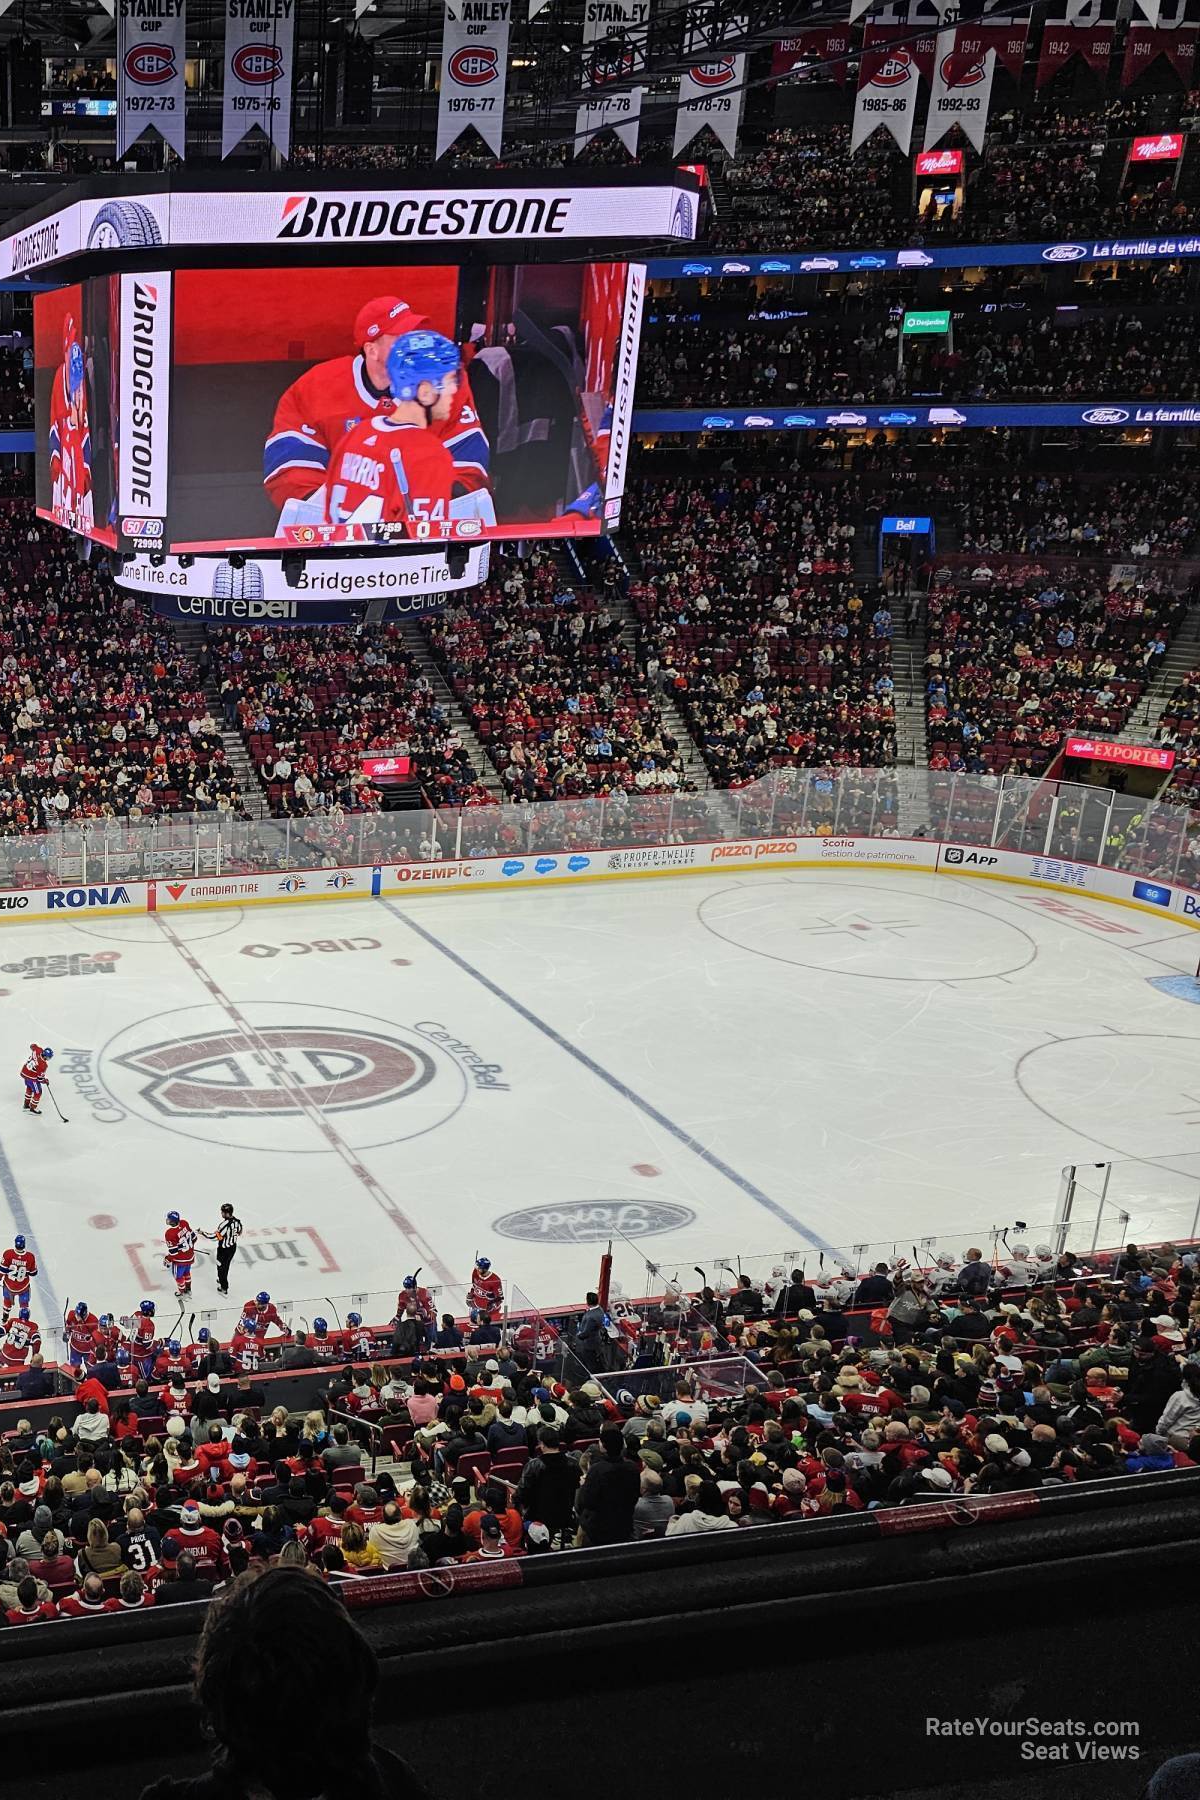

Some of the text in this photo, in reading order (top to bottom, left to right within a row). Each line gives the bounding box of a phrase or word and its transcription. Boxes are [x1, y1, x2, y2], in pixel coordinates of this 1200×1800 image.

[121, 0, 182, 18] STANLEY
[229, 0, 292, 18] STANLEY
[141, 20, 162, 32] CUP
[250, 21, 271, 33] CUP
[467, 24, 488, 36] CUP
[780, 38, 801, 52] 1952
[826, 38, 845, 52] 1963
[961, 40, 981, 54] 1947
[1048, 42, 1069, 55] 1942
[1091, 43, 1110, 56] 1960
[1134, 42, 1152, 56] 1941
[125, 97, 175, 111] 1972-73
[232, 97, 282, 111] 1975-76
[448, 98, 496, 113] 1976-77
[862, 98, 907, 112] 1985-86
[937, 97, 981, 112] 1992-93
[1137, 142, 1177, 158] Molson
[920, 157, 957, 171] Molson
[276, 196, 572, 239] BRIDGESTONE
[11, 221, 60, 272] BRIDGESTONE
[1093, 246, 1109, 257] La
[1112, 243, 1156, 256] famille
[1158, 242, 1176, 254] de
[915, 319, 946, 328] Desjardins
[611, 272, 640, 488] BRIDGESTONE
[131, 281, 159, 508] BRIDGESTONE
[1088, 409, 1121, 421] Ford
[1135, 409, 1153, 421] La
[412, 498, 445, 521] 54
[371, 523, 402, 533] 17:59
[417, 521, 430, 538] 0
[896, 520, 916, 531] Bell
[346, 525, 355, 541] 1
[1095, 744, 1152, 762] EXPORT
[372, 761, 399, 774] Molson
[822, 839, 855, 848] Scotia
[661, 848, 696, 859] TWELVE
[711, 841, 797, 862] pizza pizza
[821, 850, 853, 858] Gestion
[866, 851, 916, 862] patrimoine
[654, 859, 695, 867] WHISKEY
[1030, 857, 1089, 887] IBM
[47, 886, 131, 908] RONA
[191, 884, 259, 898] CANADIAN TIRE
[1146, 888, 1159, 898] 5G
[282, 937, 382, 956] CIBC
[414, 1020, 510, 1091] CentreBell
[60, 1048, 128, 1123] CentreBell
[535, 1205, 649, 1237] Ford
[130, 1534, 146, 1544] PRICE
[128, 1540, 158, 1570] 31
